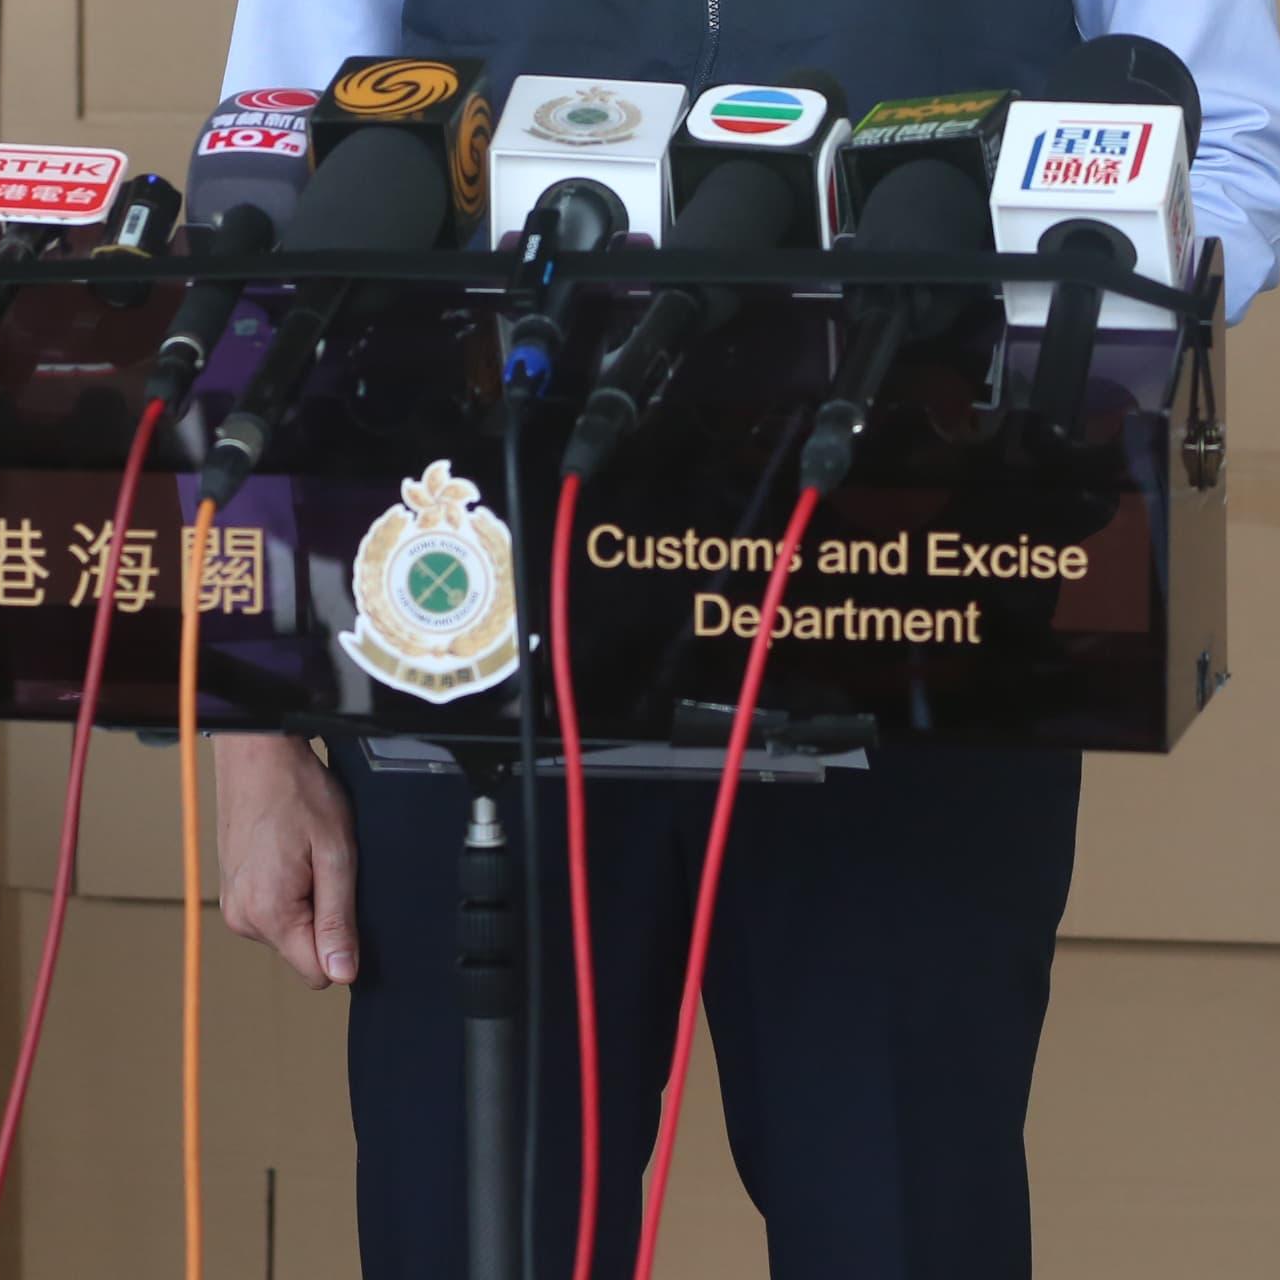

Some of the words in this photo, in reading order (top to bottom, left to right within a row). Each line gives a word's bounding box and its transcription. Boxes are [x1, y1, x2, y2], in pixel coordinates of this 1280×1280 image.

[207, 128, 290, 150] HOY
[1052, 127, 1130, 155] 星島
[1042, 157, 1123, 185] 頭條
[817, 531, 909, 575] and
[926, 533, 1089, 580] Excise
[694, 593, 982, 649] Department
